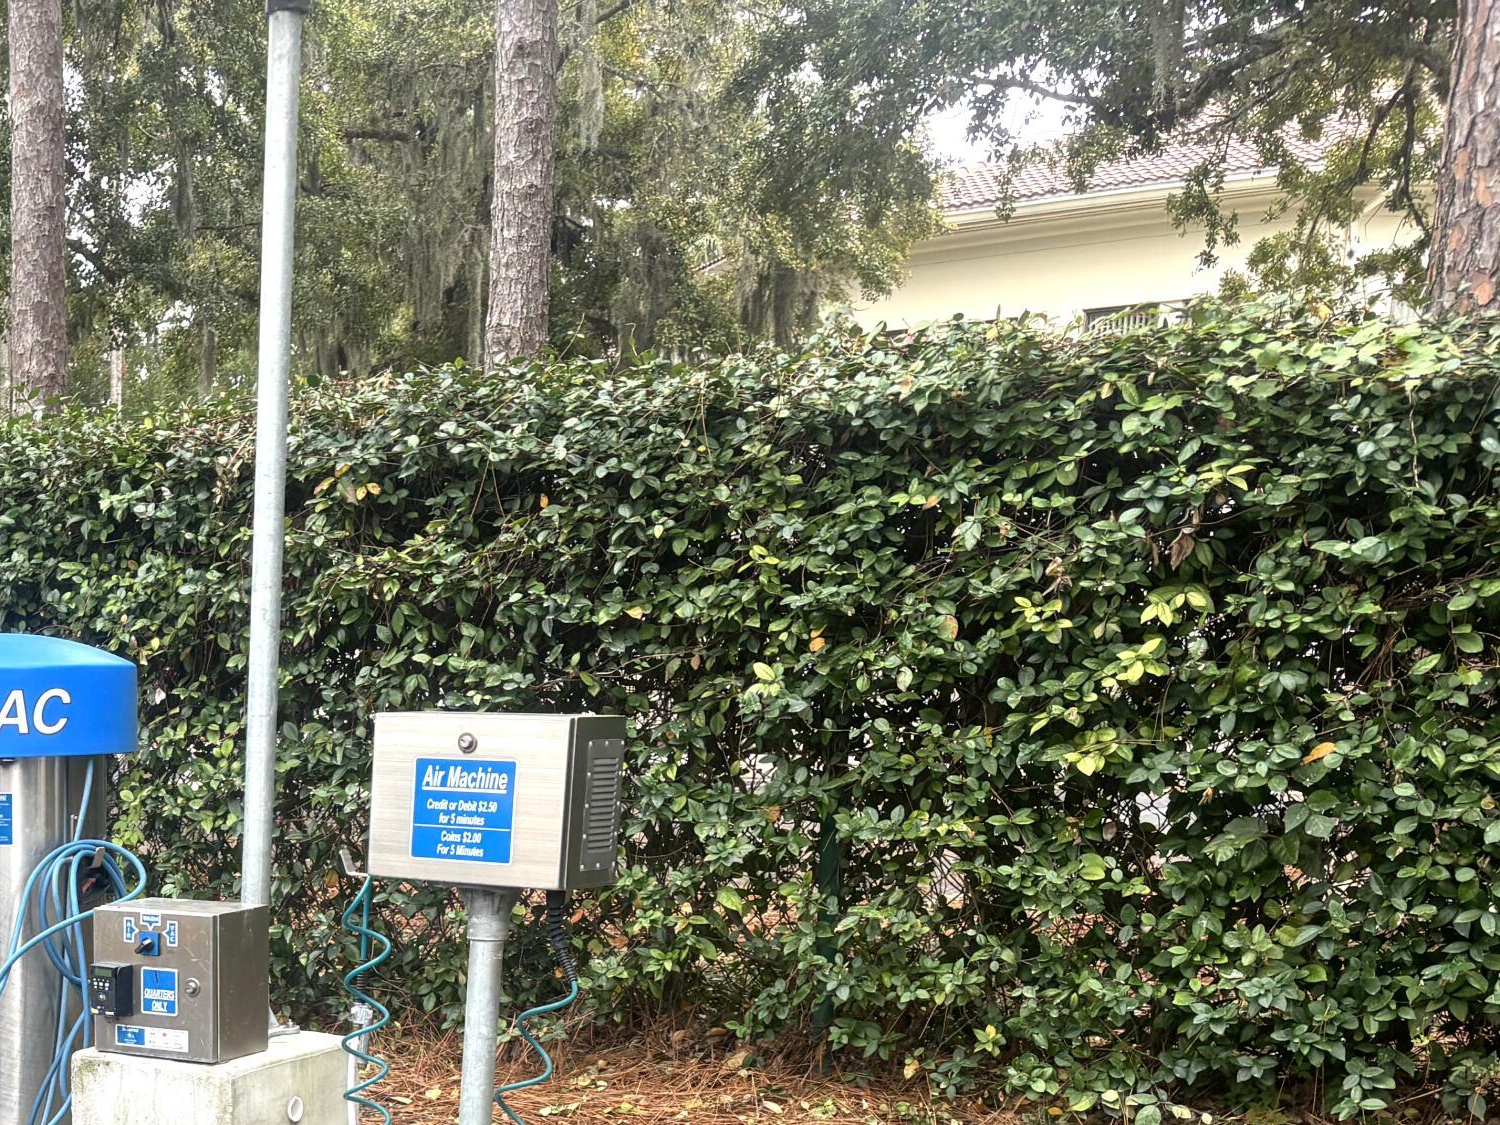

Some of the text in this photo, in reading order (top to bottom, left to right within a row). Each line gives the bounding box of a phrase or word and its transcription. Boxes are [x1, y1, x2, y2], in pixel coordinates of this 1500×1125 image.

[422, 764, 508, 790] Air Machine
[426, 798, 498, 813] Credit or Debit $2.50
[438, 812, 485, 826] for 5 minutes
[441, 830, 482, 844] Coins $2.00
[436, 844, 484, 857] For 5 Minutes
[144, 988, 174, 1000] QUARTERS
[152, 1000, 167, 1012] ONLY
